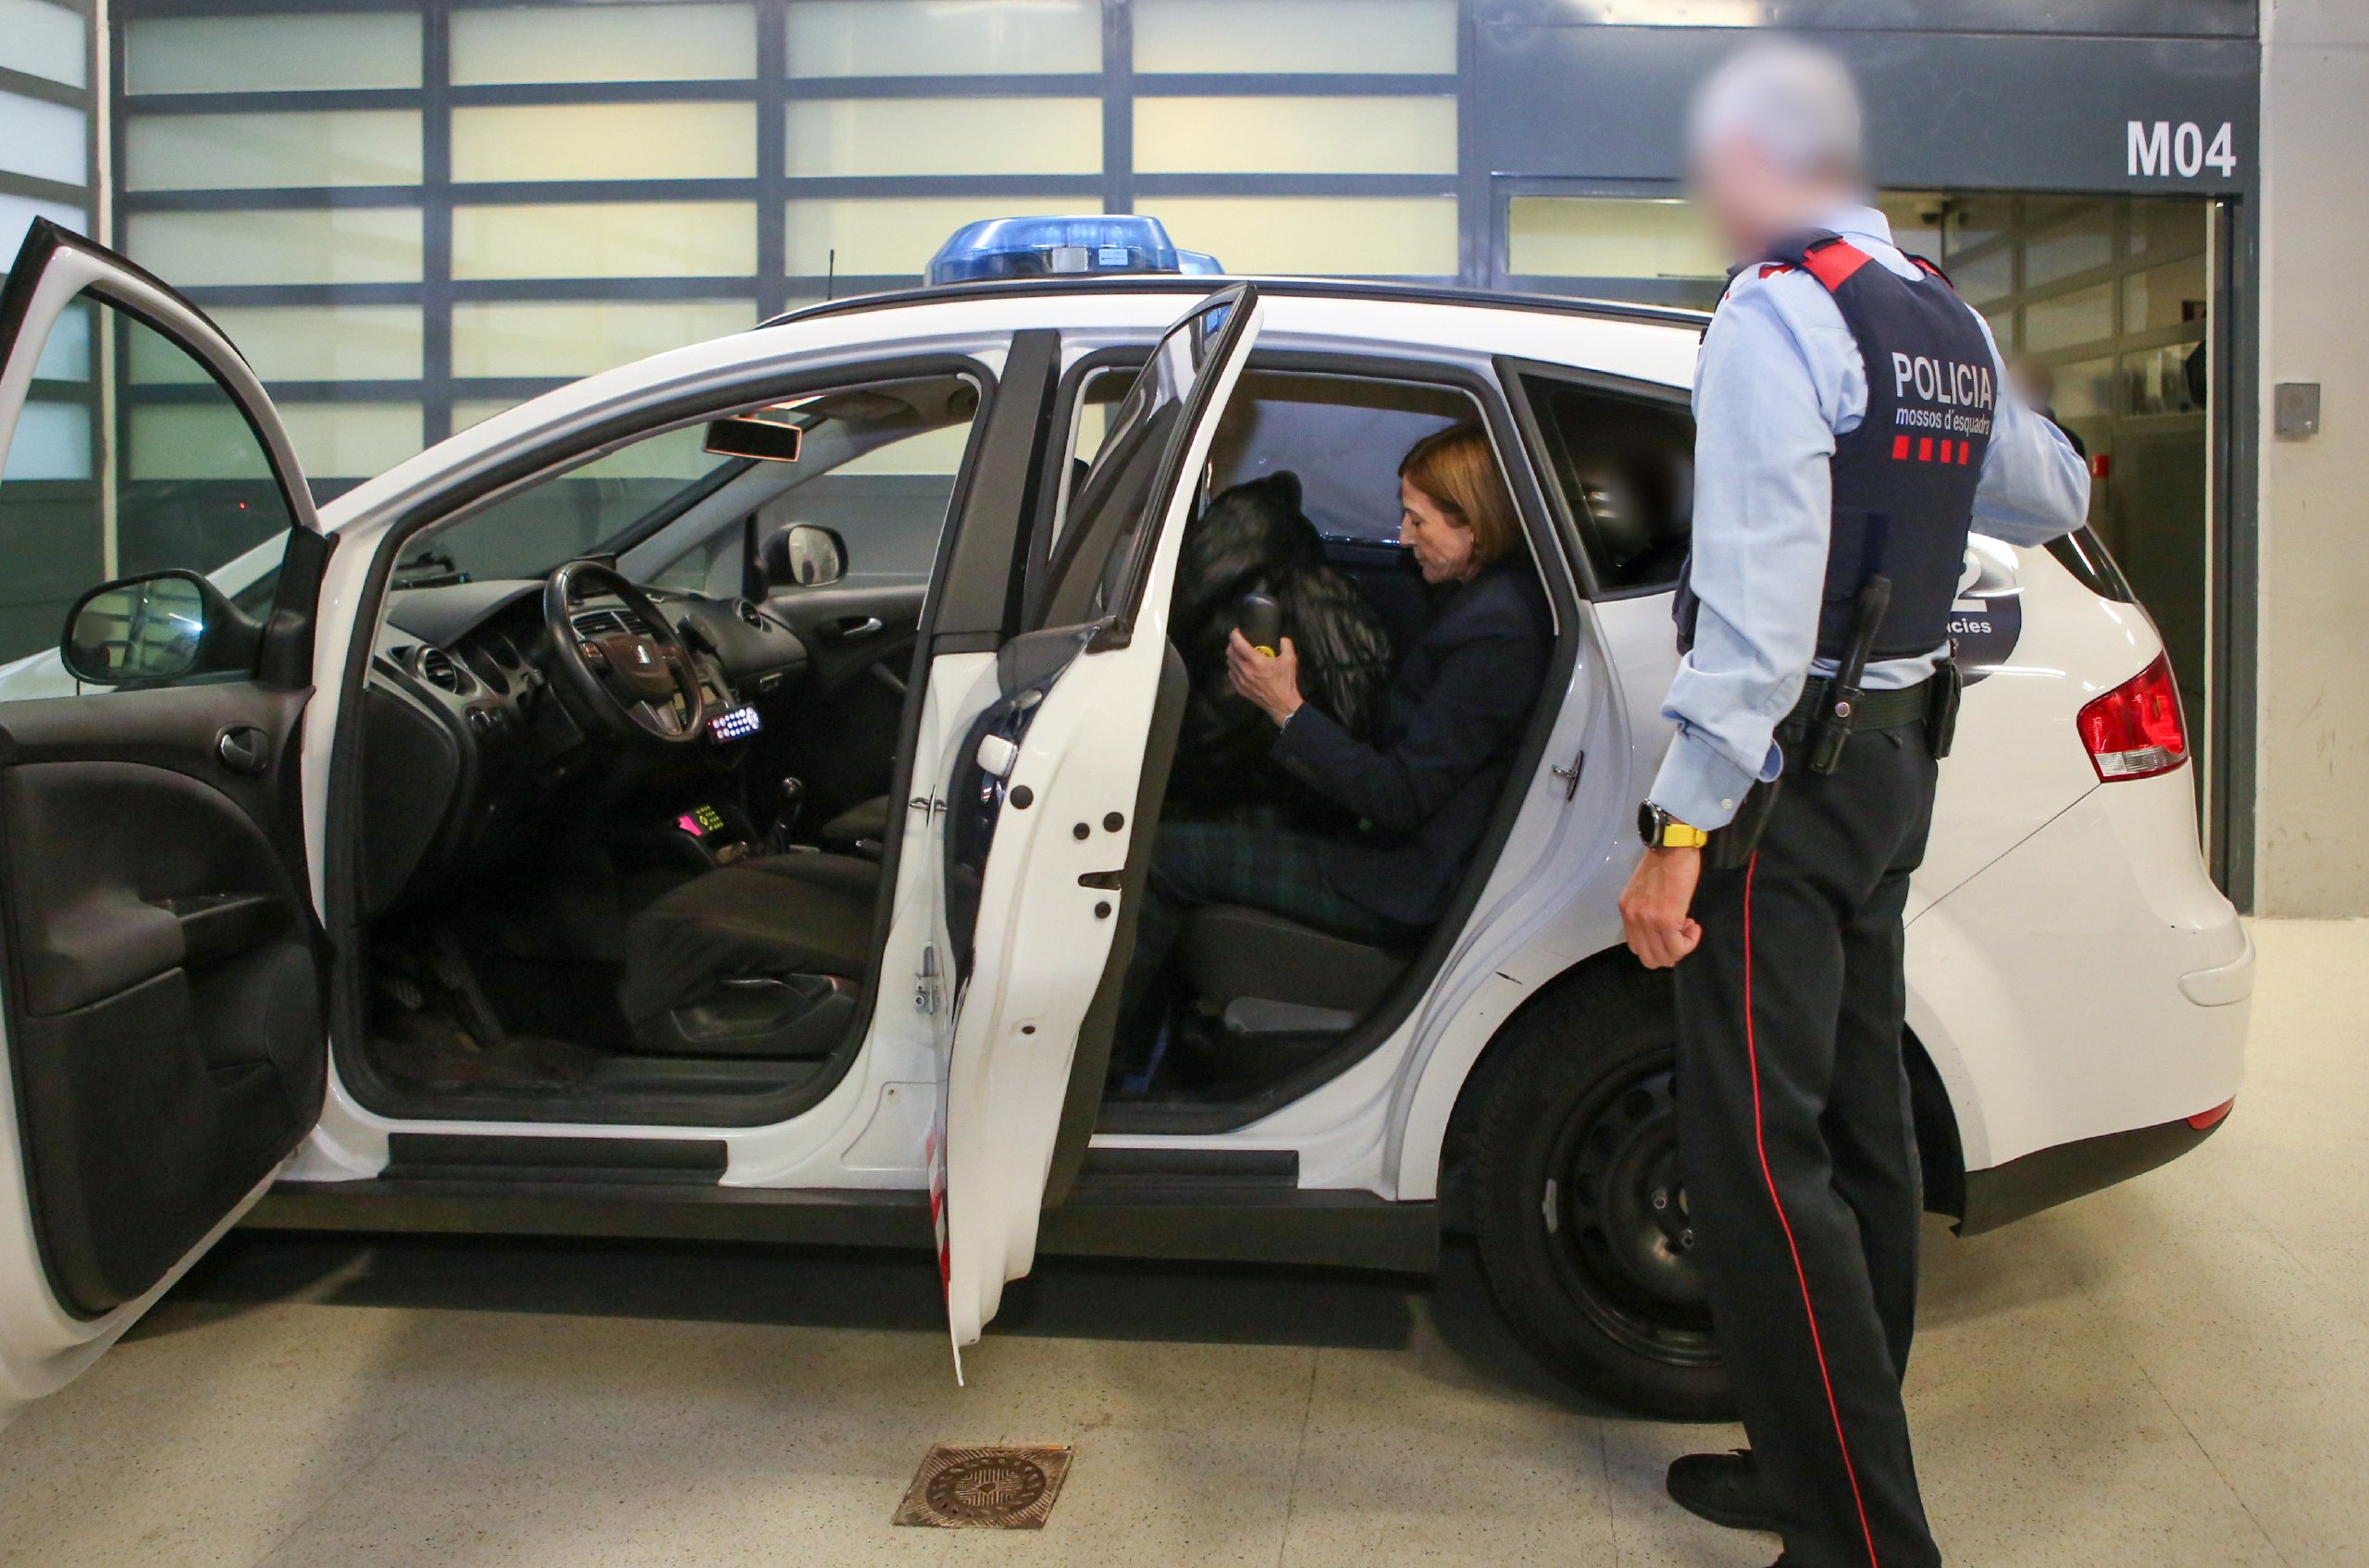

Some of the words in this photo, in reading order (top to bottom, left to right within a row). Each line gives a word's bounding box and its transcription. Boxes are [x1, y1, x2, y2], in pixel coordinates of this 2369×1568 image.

[2128, 121, 2236, 177] M04
[1892, 352, 1992, 410] POLICIA
[1896, 408, 1941, 427] mossos
